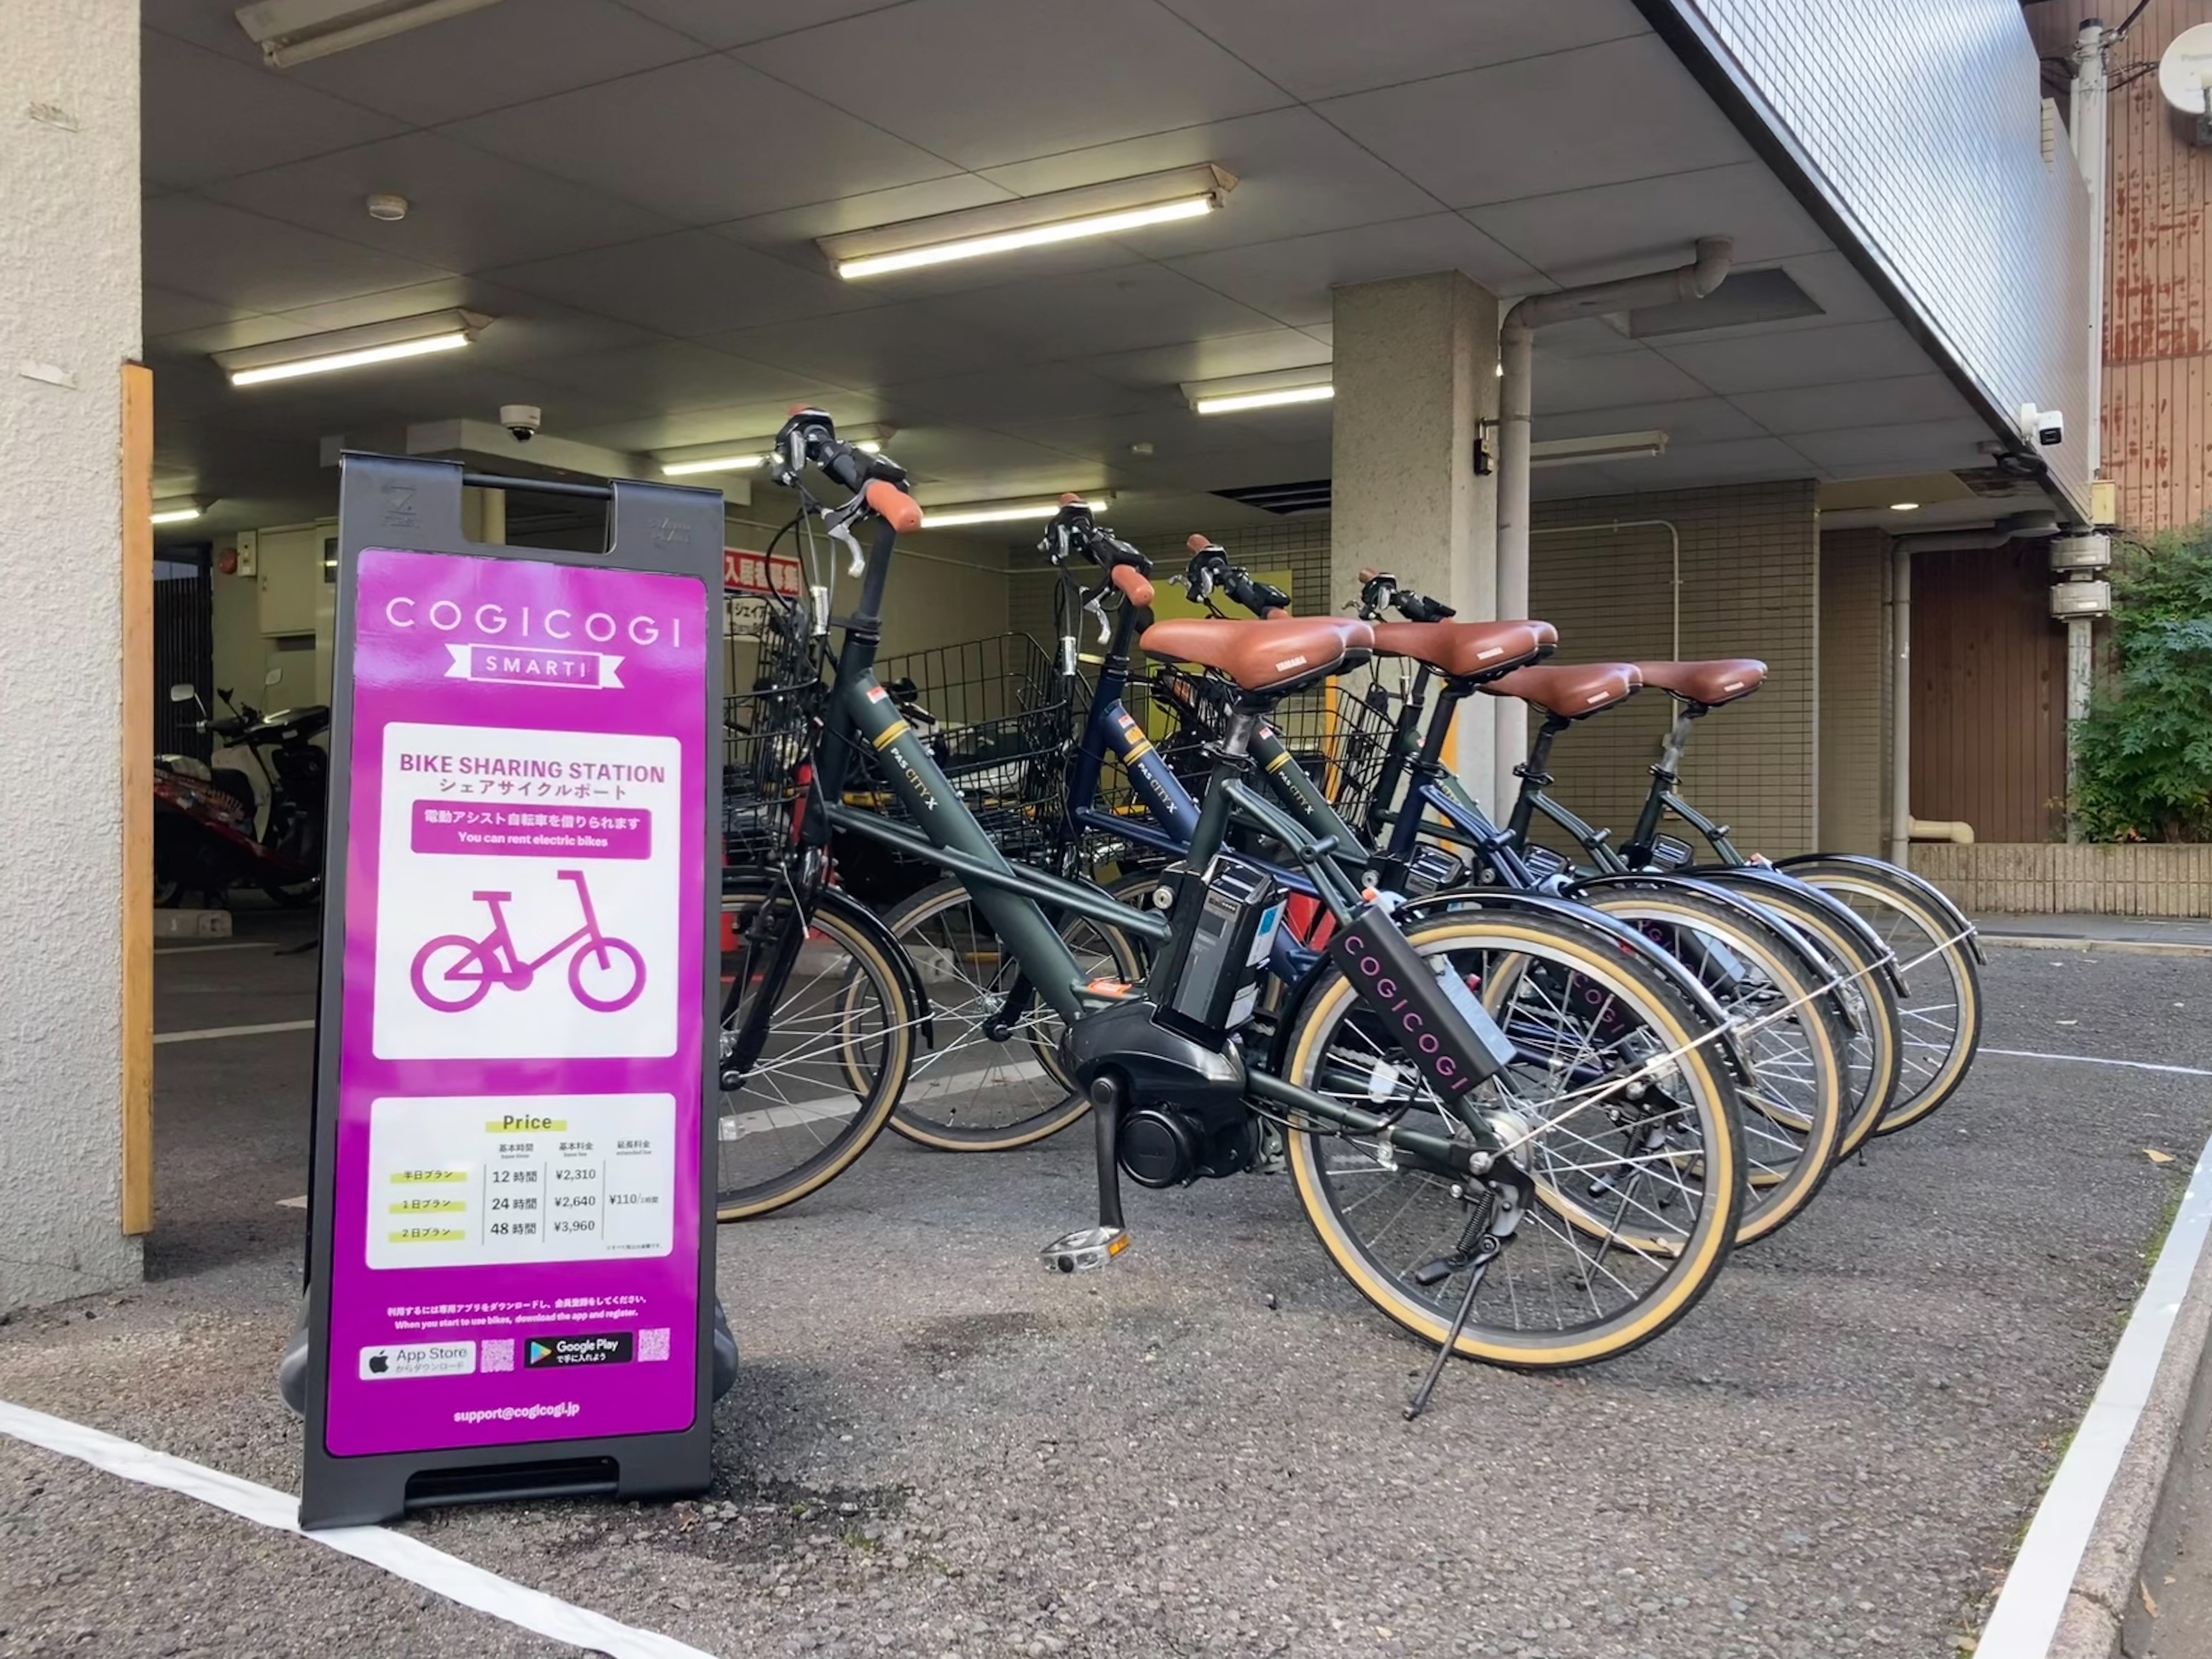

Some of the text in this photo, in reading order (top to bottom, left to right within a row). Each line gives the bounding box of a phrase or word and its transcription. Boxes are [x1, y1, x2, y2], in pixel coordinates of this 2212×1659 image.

[386, 597, 680, 647] COGICOGI
[486, 656, 585, 678] SMART!
[400, 754, 664, 783] BIKE SHARING STATION
[890, 747, 938, 811] PAS CITY X
[440, 778, 625, 800] シェアサイクルポート
[1138, 763, 1177, 814] PAS CITY X
[424, 809, 640, 830] 電動アシスト自転車を借りられます
[1305, 805, 1314, 815] X
[458, 831, 608, 847] You can rent electric bikes
[1345, 935, 1469, 1090] COGICOGI
[504, 1114, 552, 1130] Price
[499, 1143, 534, 1153] 基本時間
[559, 1142, 593, 1150] 基本料金
[404, 1169, 596, 1183] 半日プラン 12 時間 ¥2,310
[492, 1198, 509, 1210] 24
[513, 1198, 537, 1210] 時間
[555, 1196, 596, 1209] ¥2,640
[490, 1223, 509, 1234] 48
[512, 1222, 537, 1234] 時間
[554, 1220, 595, 1233] ¥3,960
[395, 1321, 420, 1329] When
[421, 1321, 438, 1330] you
[439, 1319, 459, 1327] start
[471, 1317, 486, 1325] use
[487, 1316, 512, 1324] bikes,
[515, 1313, 556, 1323] download
[557, 1312, 571, 1321] the
[572, 1312, 588, 1321] app
[589, 1310, 605, 1319] and
[606, 1309, 639, 1319] register.
[397, 1339, 618, 1363] App Store Google Play
[396, 1353, 606, 1373] からダウンロード で手に入れよう
[454, 1401, 580, 1424] support@cogicogi.jp
